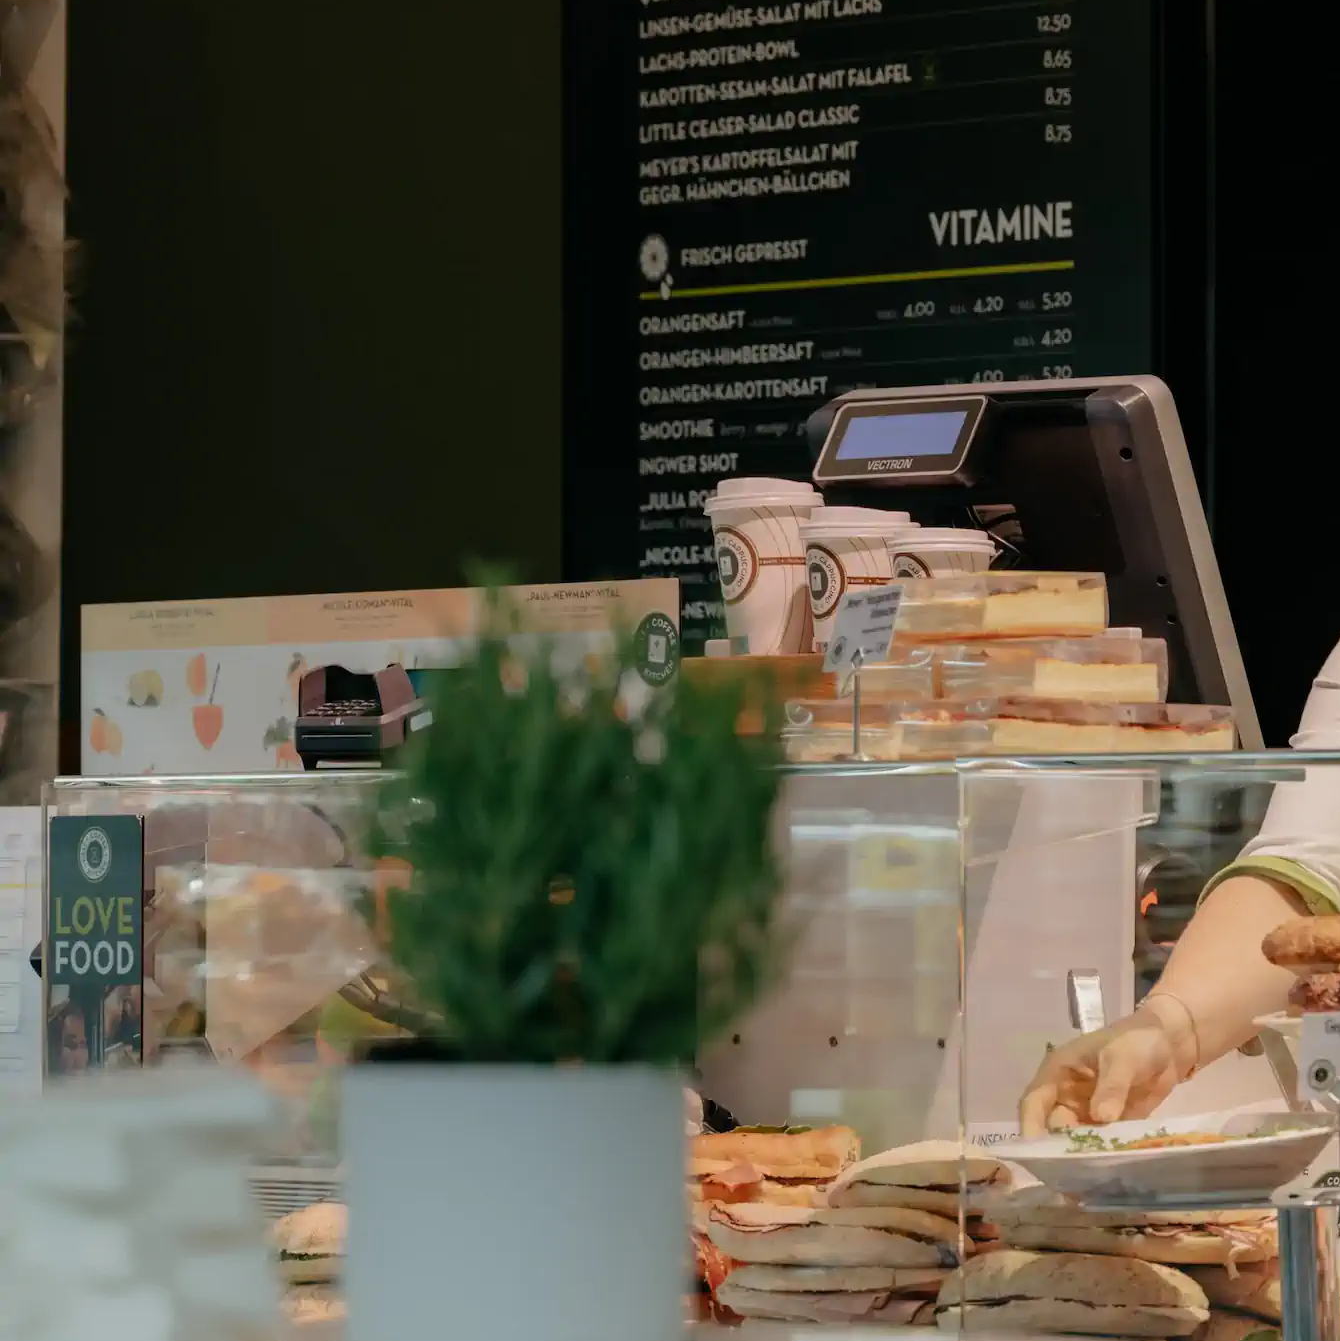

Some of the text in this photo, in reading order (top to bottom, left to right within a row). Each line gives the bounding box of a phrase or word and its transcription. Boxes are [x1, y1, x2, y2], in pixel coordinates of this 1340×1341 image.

[638, 0, 802, 40] LINSEN-GEMÜSE-SALAT
[638, 39, 801, 75] LACHS-PROTEIN-BOWL
[638, 71, 818, 109] KAROTTEN-SESAM-SALAT
[819, 70, 846, 93] MIT
[847, 63, 914, 89] FALAFEL
[638, 118, 687, 144] LITTLE
[688, 110, 796, 140] CEASER-SALAD
[797, 103, 860, 132] CLASSIC
[703, 143, 830, 173] KARTOFFELSALAT
[831, 139, 859, 161] MIT
[638, 168, 851, 206] GEGR. HÄHNCHEN-BÄLLCHEN
[928, 200, 1073, 249] VITAMINE
[681, 238, 809, 270] FRISCH GEPRESST
[638, 310, 747, 337] ORANGENSAFT
[638, 340, 816, 371] ORANGEN-HIMBEERSAFT
[638, 375, 830, 407] ORANGEN-KAROTTENSAFT
[638, 417, 716, 441] SMOOTHIE
[638, 452, 739, 477] INGWER SHOT
[866, 457, 914, 474] VECTRON
[55, 896, 135, 937] LOVE
[55, 940, 135, 976] FOOD
